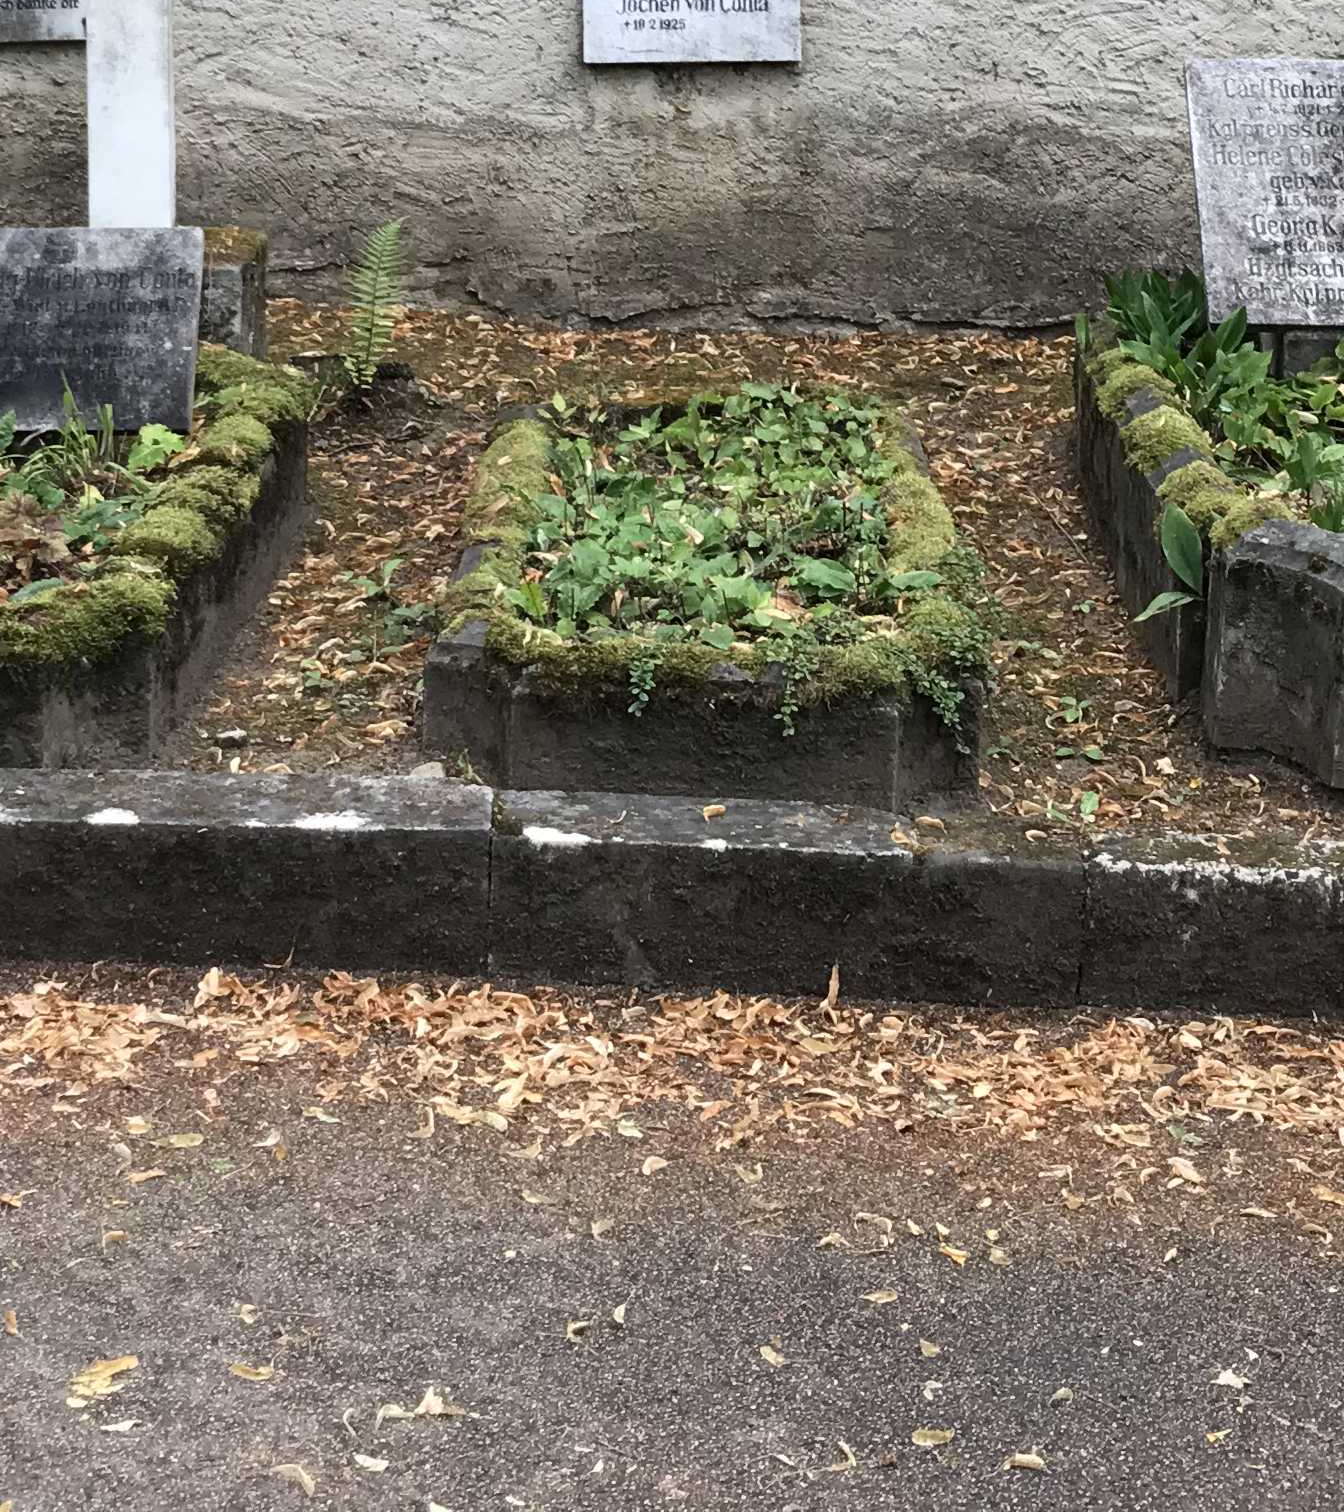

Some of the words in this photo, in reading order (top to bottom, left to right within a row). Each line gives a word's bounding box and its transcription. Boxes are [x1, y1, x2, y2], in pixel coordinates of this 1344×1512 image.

[1223, 77, 1266, 99] Carl
[1212, 143, 1282, 167] Helene
[1251, 213, 1318, 239] Georg
